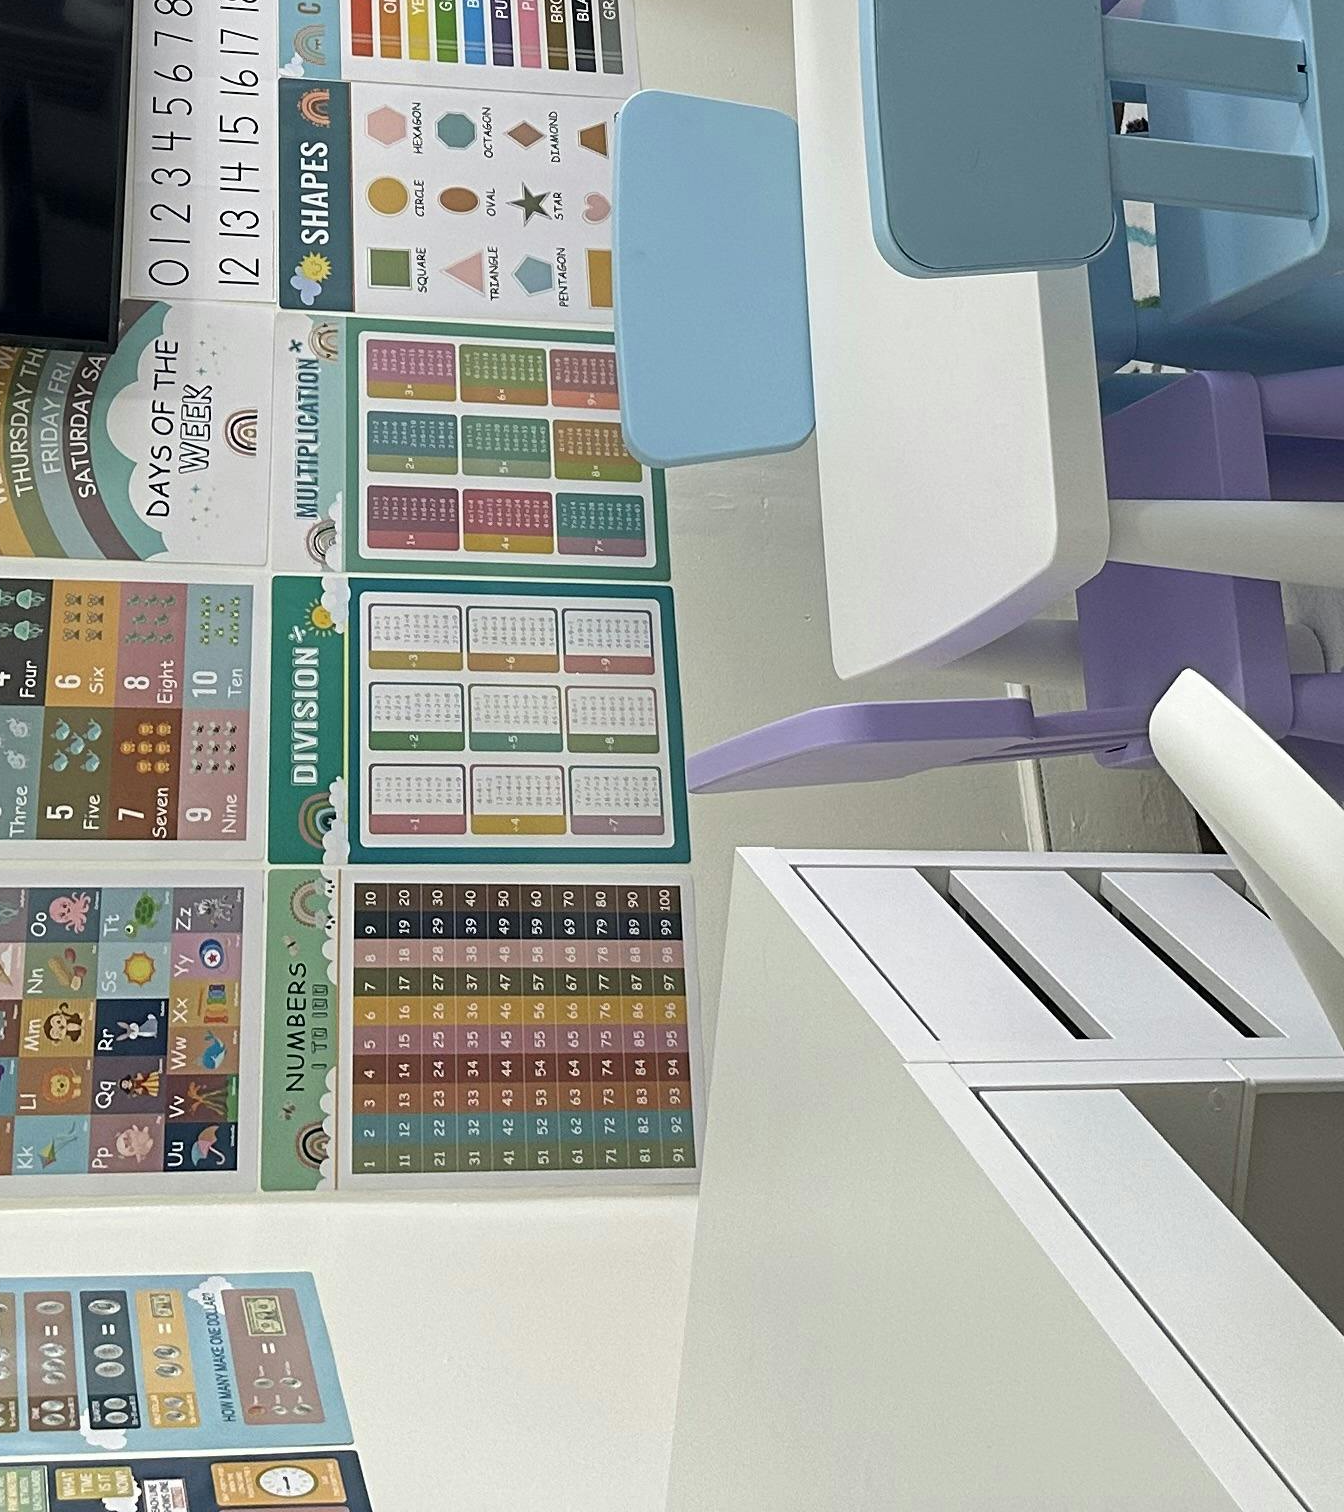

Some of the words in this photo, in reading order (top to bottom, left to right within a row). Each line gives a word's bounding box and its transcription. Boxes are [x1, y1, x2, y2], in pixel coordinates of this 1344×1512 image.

[154, 31, 193, 46] 7
[220, 29, 259, 56] 17
[154, 64, 192, 83] 6
[220, 70, 259, 96] 16
[153, 97, 191, 116] 5
[152, 131, 191, 151] 4
[219, 115, 259, 145] 15
[411, 102, 423, 154] HEXAGON
[482, 107, 494, 158] OCTAGON
[548, 111, 561, 163] DIAMOND
[151, 168, 190, 187] 3
[219, 162, 260, 193] 14
[300, 142, 330, 245] SHAPES
[414, 180, 425, 217] CIRCLE
[486, 188, 497, 217] OVAL
[553, 192, 564, 221] STAR
[150, 203, 190, 224] 2
[218, 211, 259, 238] 13
[148, 260, 189, 286] 0
[218, 258, 259, 286] 12
[415, 247, 428, 293] SQUARE
[487, 246, 500, 301] TRIANGLE
[555, 247, 569, 307] PENTAGON
[48, 361, 75, 393] FRI.
[153, 339, 179, 390] THE
[152, 400, 175, 435] OF
[178, 384, 212, 473] WEEK
[10, 383, 34, 498] THURSDAY
[41, 398, 62, 474] FRIDAY
[70, 383, 98, 499] SATURDAY
[294, 358, 321, 520] MULTIPLICATION
[146, 445, 172, 517] DAYS
[20, 660, 38, 698] Four
[55, 674, 81, 689] 6
[89, 666, 105, 694] Six
[124, 676, 150, 690] 8
[157, 660, 177, 704] Eight
[192, 670, 219, 698] 10
[228, 668, 244, 698] Ten
[290, 647, 320, 786] DIVISION
[10, 786, 29, 837] Three
[46, 805, 74, 820] 5
[84, 795, 102, 830] Five
[118, 808, 144, 820] 7
[153, 788, 169, 838] Seven
[186, 808, 212, 821] 9
[222, 794, 239, 833] Nine
[658, 890, 671, 911] 100
[31, 913, 47, 937] Oo
[398, 920, 411, 934] 19
[311, 984, 328, 1018] 100
[98, 1028, 113, 1050] Rr
[285, 962, 307, 1092] NUMBERS
[311, 1028, 327, 1053] TO
[96, 1081, 116, 1109] Qq
[202, 1293, 220, 1326] DOLLAR?
[208, 1328, 224, 1345] ONE
[212, 1347, 228, 1371] MAKE
[216, 1373, 232, 1399] MANY
[221, 1402, 236, 1422] HOW
[81, 1473, 93, 1493] TIME
